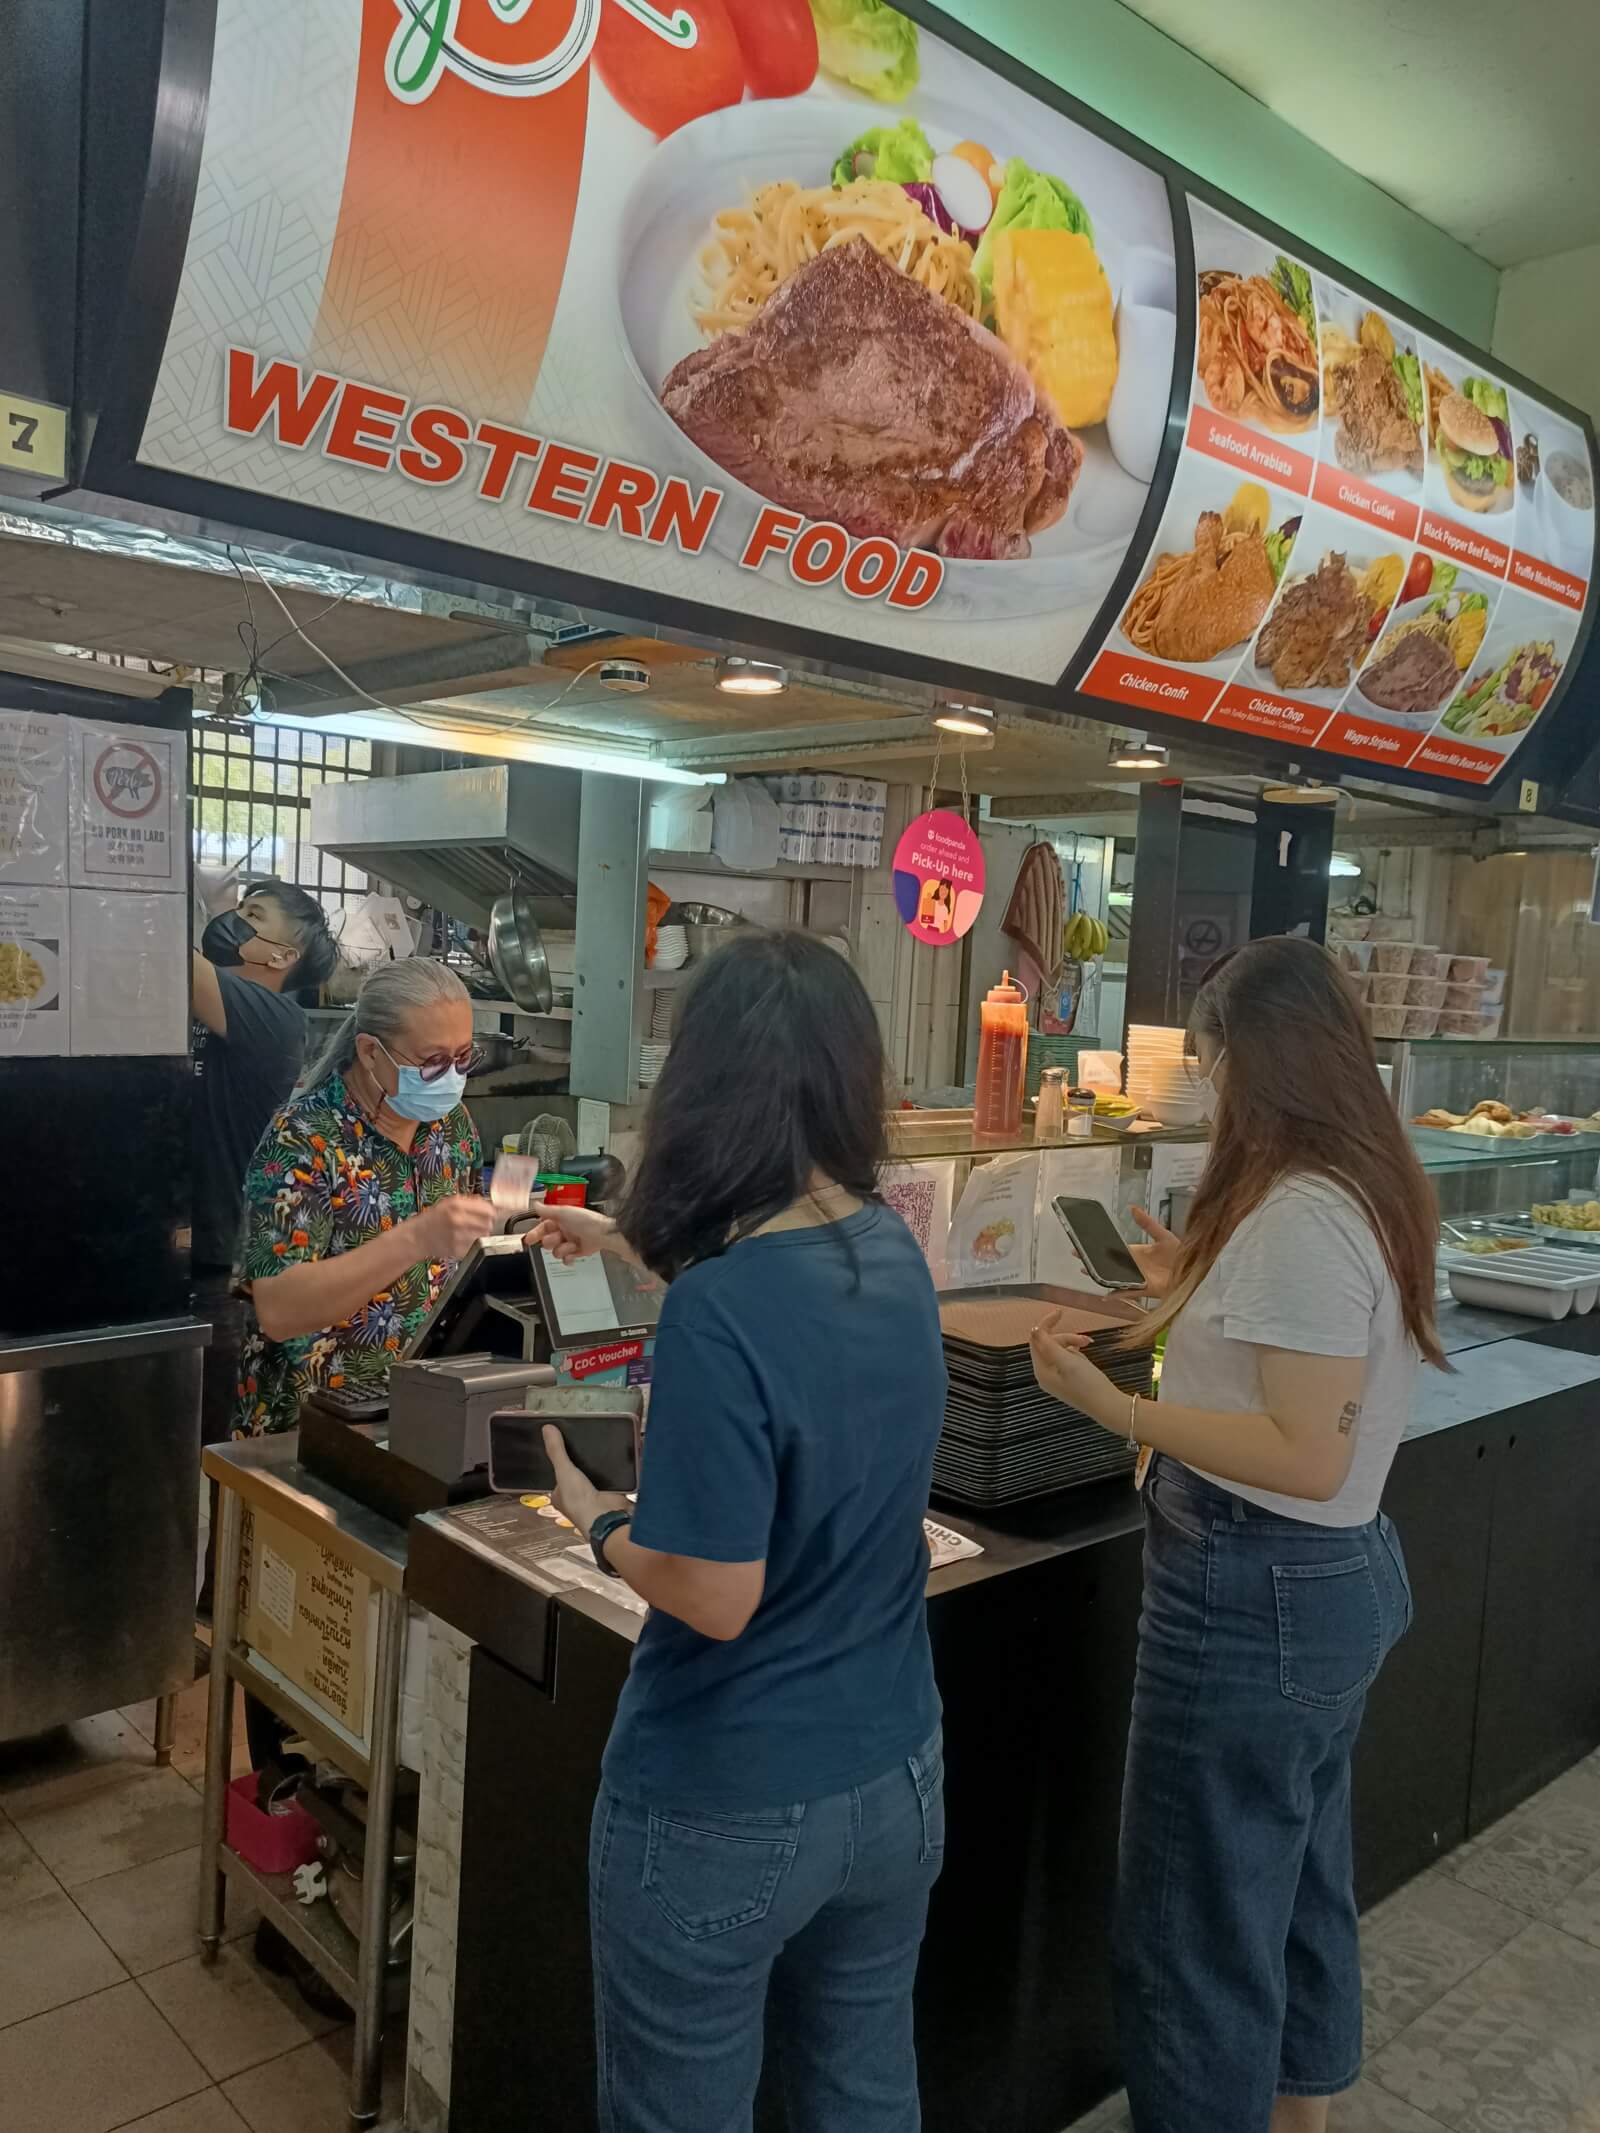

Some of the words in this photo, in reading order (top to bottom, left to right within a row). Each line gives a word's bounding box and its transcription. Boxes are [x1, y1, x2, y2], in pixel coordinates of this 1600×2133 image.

[9, 412, 39, 453] 7
[1208, 427, 1248, 457] Seafood
[1249, 446, 1292, 477] Arrabiata
[225, 346, 721, 554] WESTERN
[740, 508, 944, 610] FOOD
[1338, 486, 1370, 510] Chicken
[1371, 500, 1396, 521] Cutlet
[1423, 522, 1443, 541] Black
[1443, 530, 1468, 552] Pepper
[1467, 541, 1484, 558] Beef
[1483, 548, 1506, 569] Burger
[1515, 561, 1534, 581] Truffle
[1534, 570, 1566, 594] Mushroom
[1566, 584, 1581, 603] Soup
[1119, 672, 1159, 693] Chicken
[1158, 683, 1190, 700] Confit
[1249, 698, 1282, 716] Chicken
[1281, 706, 1304, 724] Chop
[1344, 728, 1370, 745] Wagyu
[1421, 747, 1449, 763] Mexican
[1474, 760, 1496, 773] Salad
[1525, 787, 1533, 803] 8
[105, 827, 128, 840] PORK
[130, 829, 142, 841] NO
[143, 830, 165, 842] LARD
[935, 832, 966, 850] foodpanda
[920, 842, 938, 853] order
[938, 848, 957, 860] ahead
[958, 854, 970, 864] and
[912, 852, 950, 877] Pick-Up
[951, 864, 974, 882] here
[574, 1356, 596, 1371] CDC
[598, 1346, 638, 1364] Voucher
